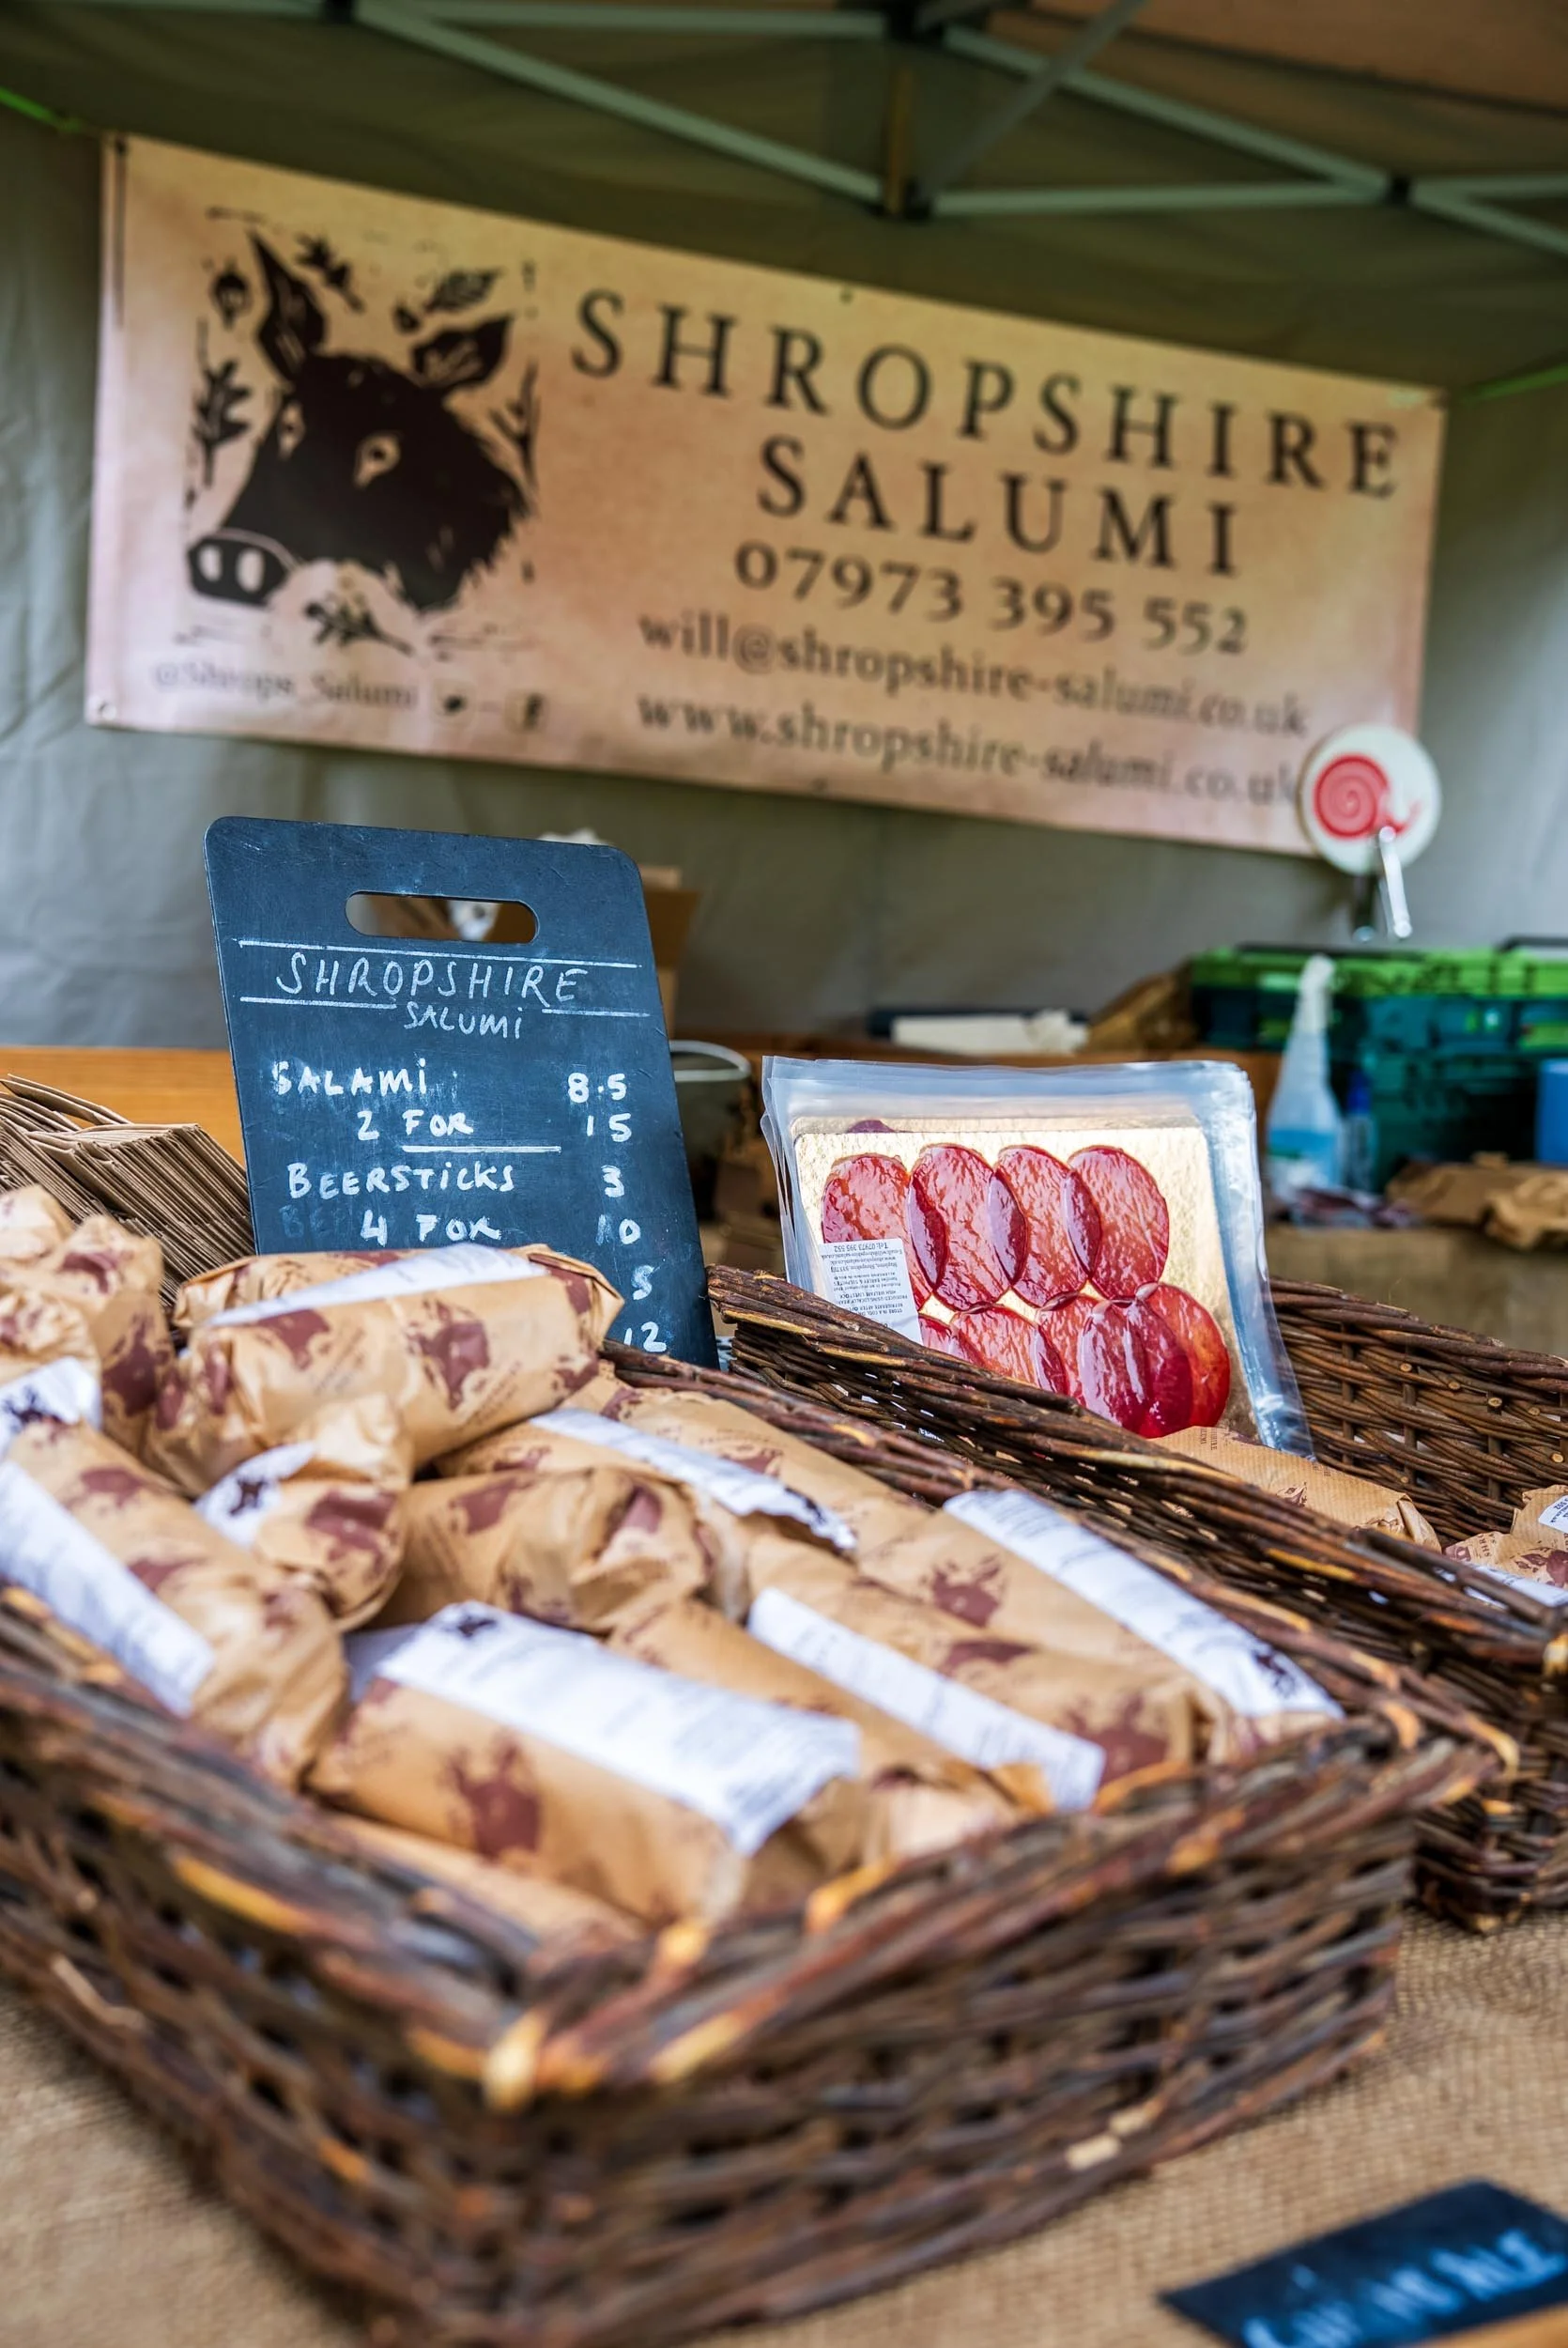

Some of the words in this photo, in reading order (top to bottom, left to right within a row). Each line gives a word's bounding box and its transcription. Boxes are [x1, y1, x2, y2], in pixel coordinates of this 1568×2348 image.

[570, 289, 1402, 500] SHROPSHIRE
[757, 434, 1239, 579] SALUMI
[733, 539, 964, 624] 07973
[989, 576, 1116, 642] 395
[1144, 596, 1249, 656] 552
[638, 609, 1308, 738] will@shropshire-salumi.co.uk
[276, 952, 589, 1002] SHROPSHIRE
[357, 1110, 379, 1141] 2
[403, 1109, 474, 1136] FOR
[587, 1113, 632, 1143] 15
[603, 1165, 625, 1197] 3
[361, 1209, 388, 1247] 4
[623, 1321, 668, 1352] 12
